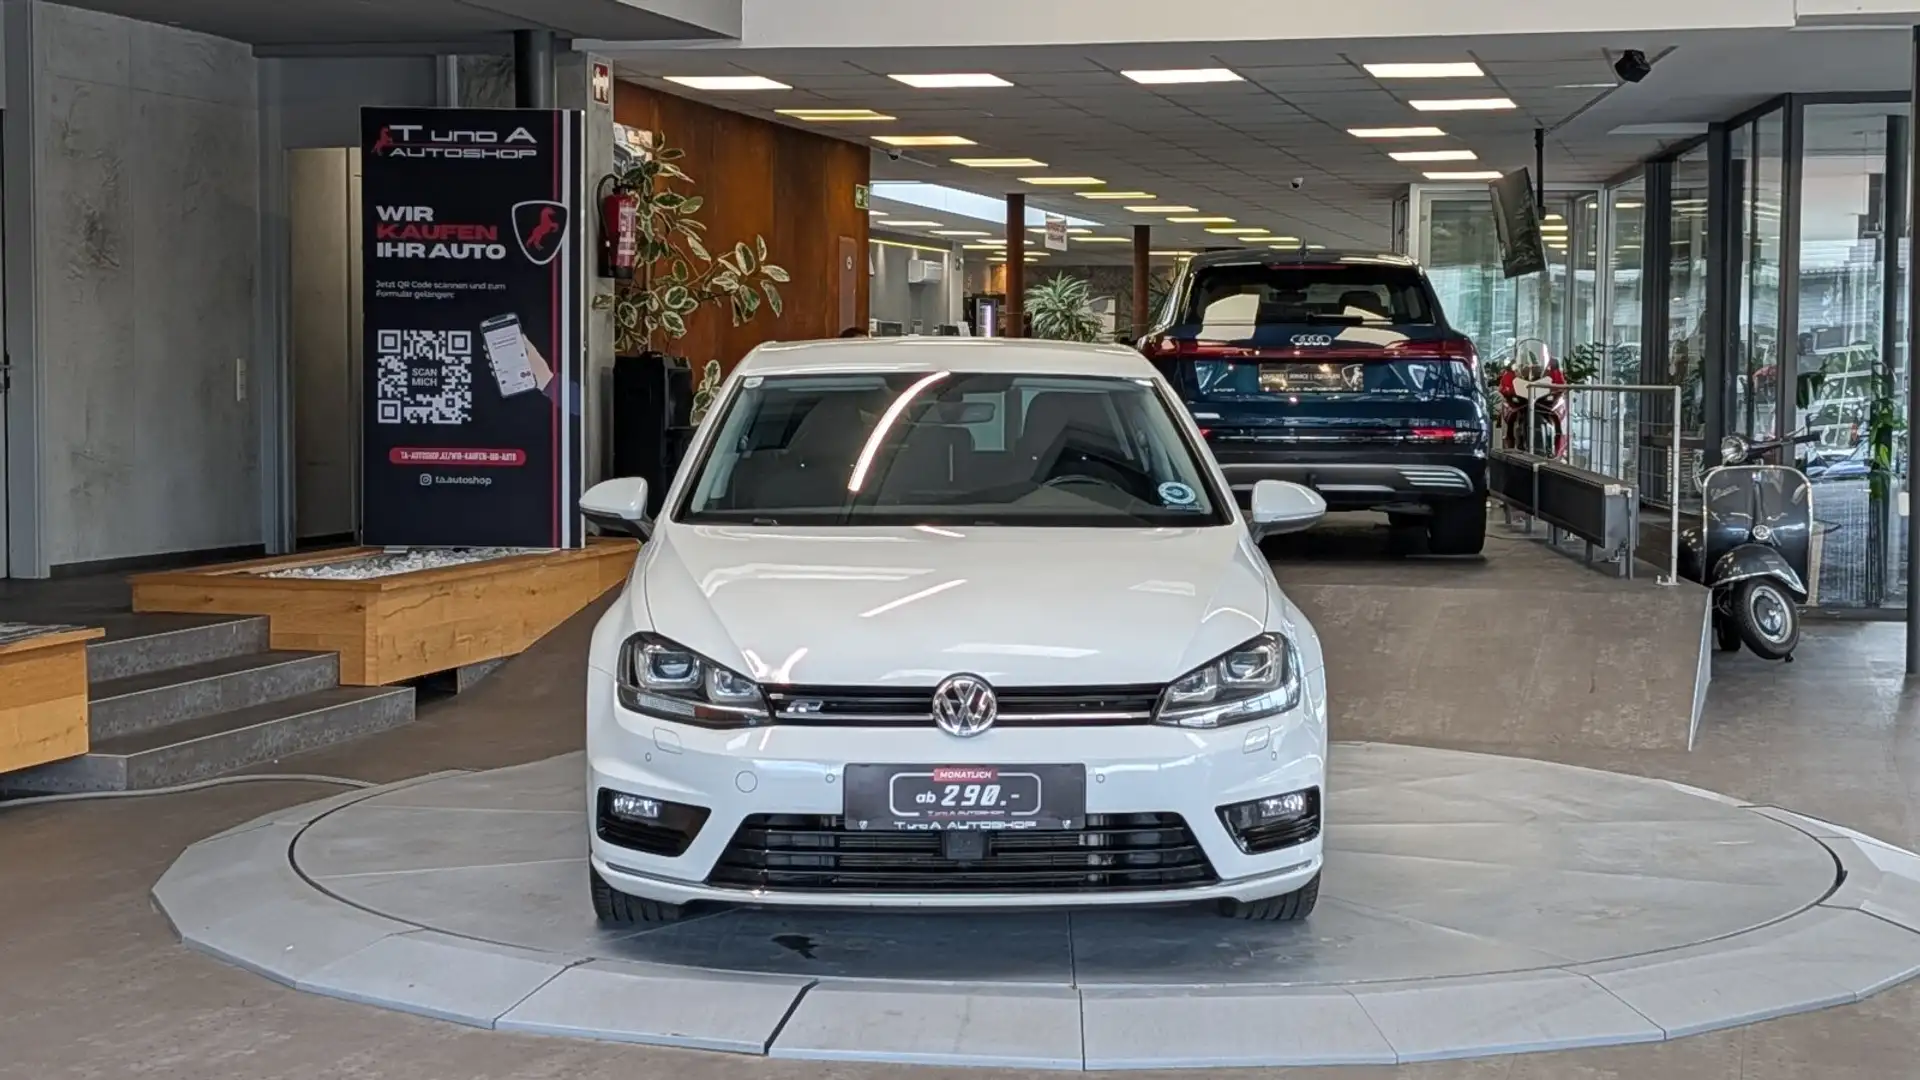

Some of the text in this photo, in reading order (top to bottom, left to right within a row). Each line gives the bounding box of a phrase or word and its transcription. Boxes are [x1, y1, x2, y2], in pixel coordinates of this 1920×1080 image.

[389, 125, 423, 141] T
[505, 127, 538, 143] A
[389, 147, 538, 159] AUTOSHOP
[376, 206, 434, 221] WIR
[376, 225, 498, 240] KAUFEN
[376, 243, 506, 260] IHR AUTO
[376, 280, 396, 288] Jetzt
[397, 281, 410, 289] QR
[411, 281, 432, 289] Code
[433, 282, 468, 290] scannen
[469, 282, 486, 290] und
[411, 368, 438, 376] SCAN
[411, 378, 438, 386] MICH
[435, 475, 492, 486] ta.autoshop
[939, 770, 992, 780] MONATLICH
[915, 785, 1020, 806] ab 290.-
[894, 821, 906, 830] T
[929, 821, 942, 830] A
[947, 820, 1037, 830] AUTOSHOP
